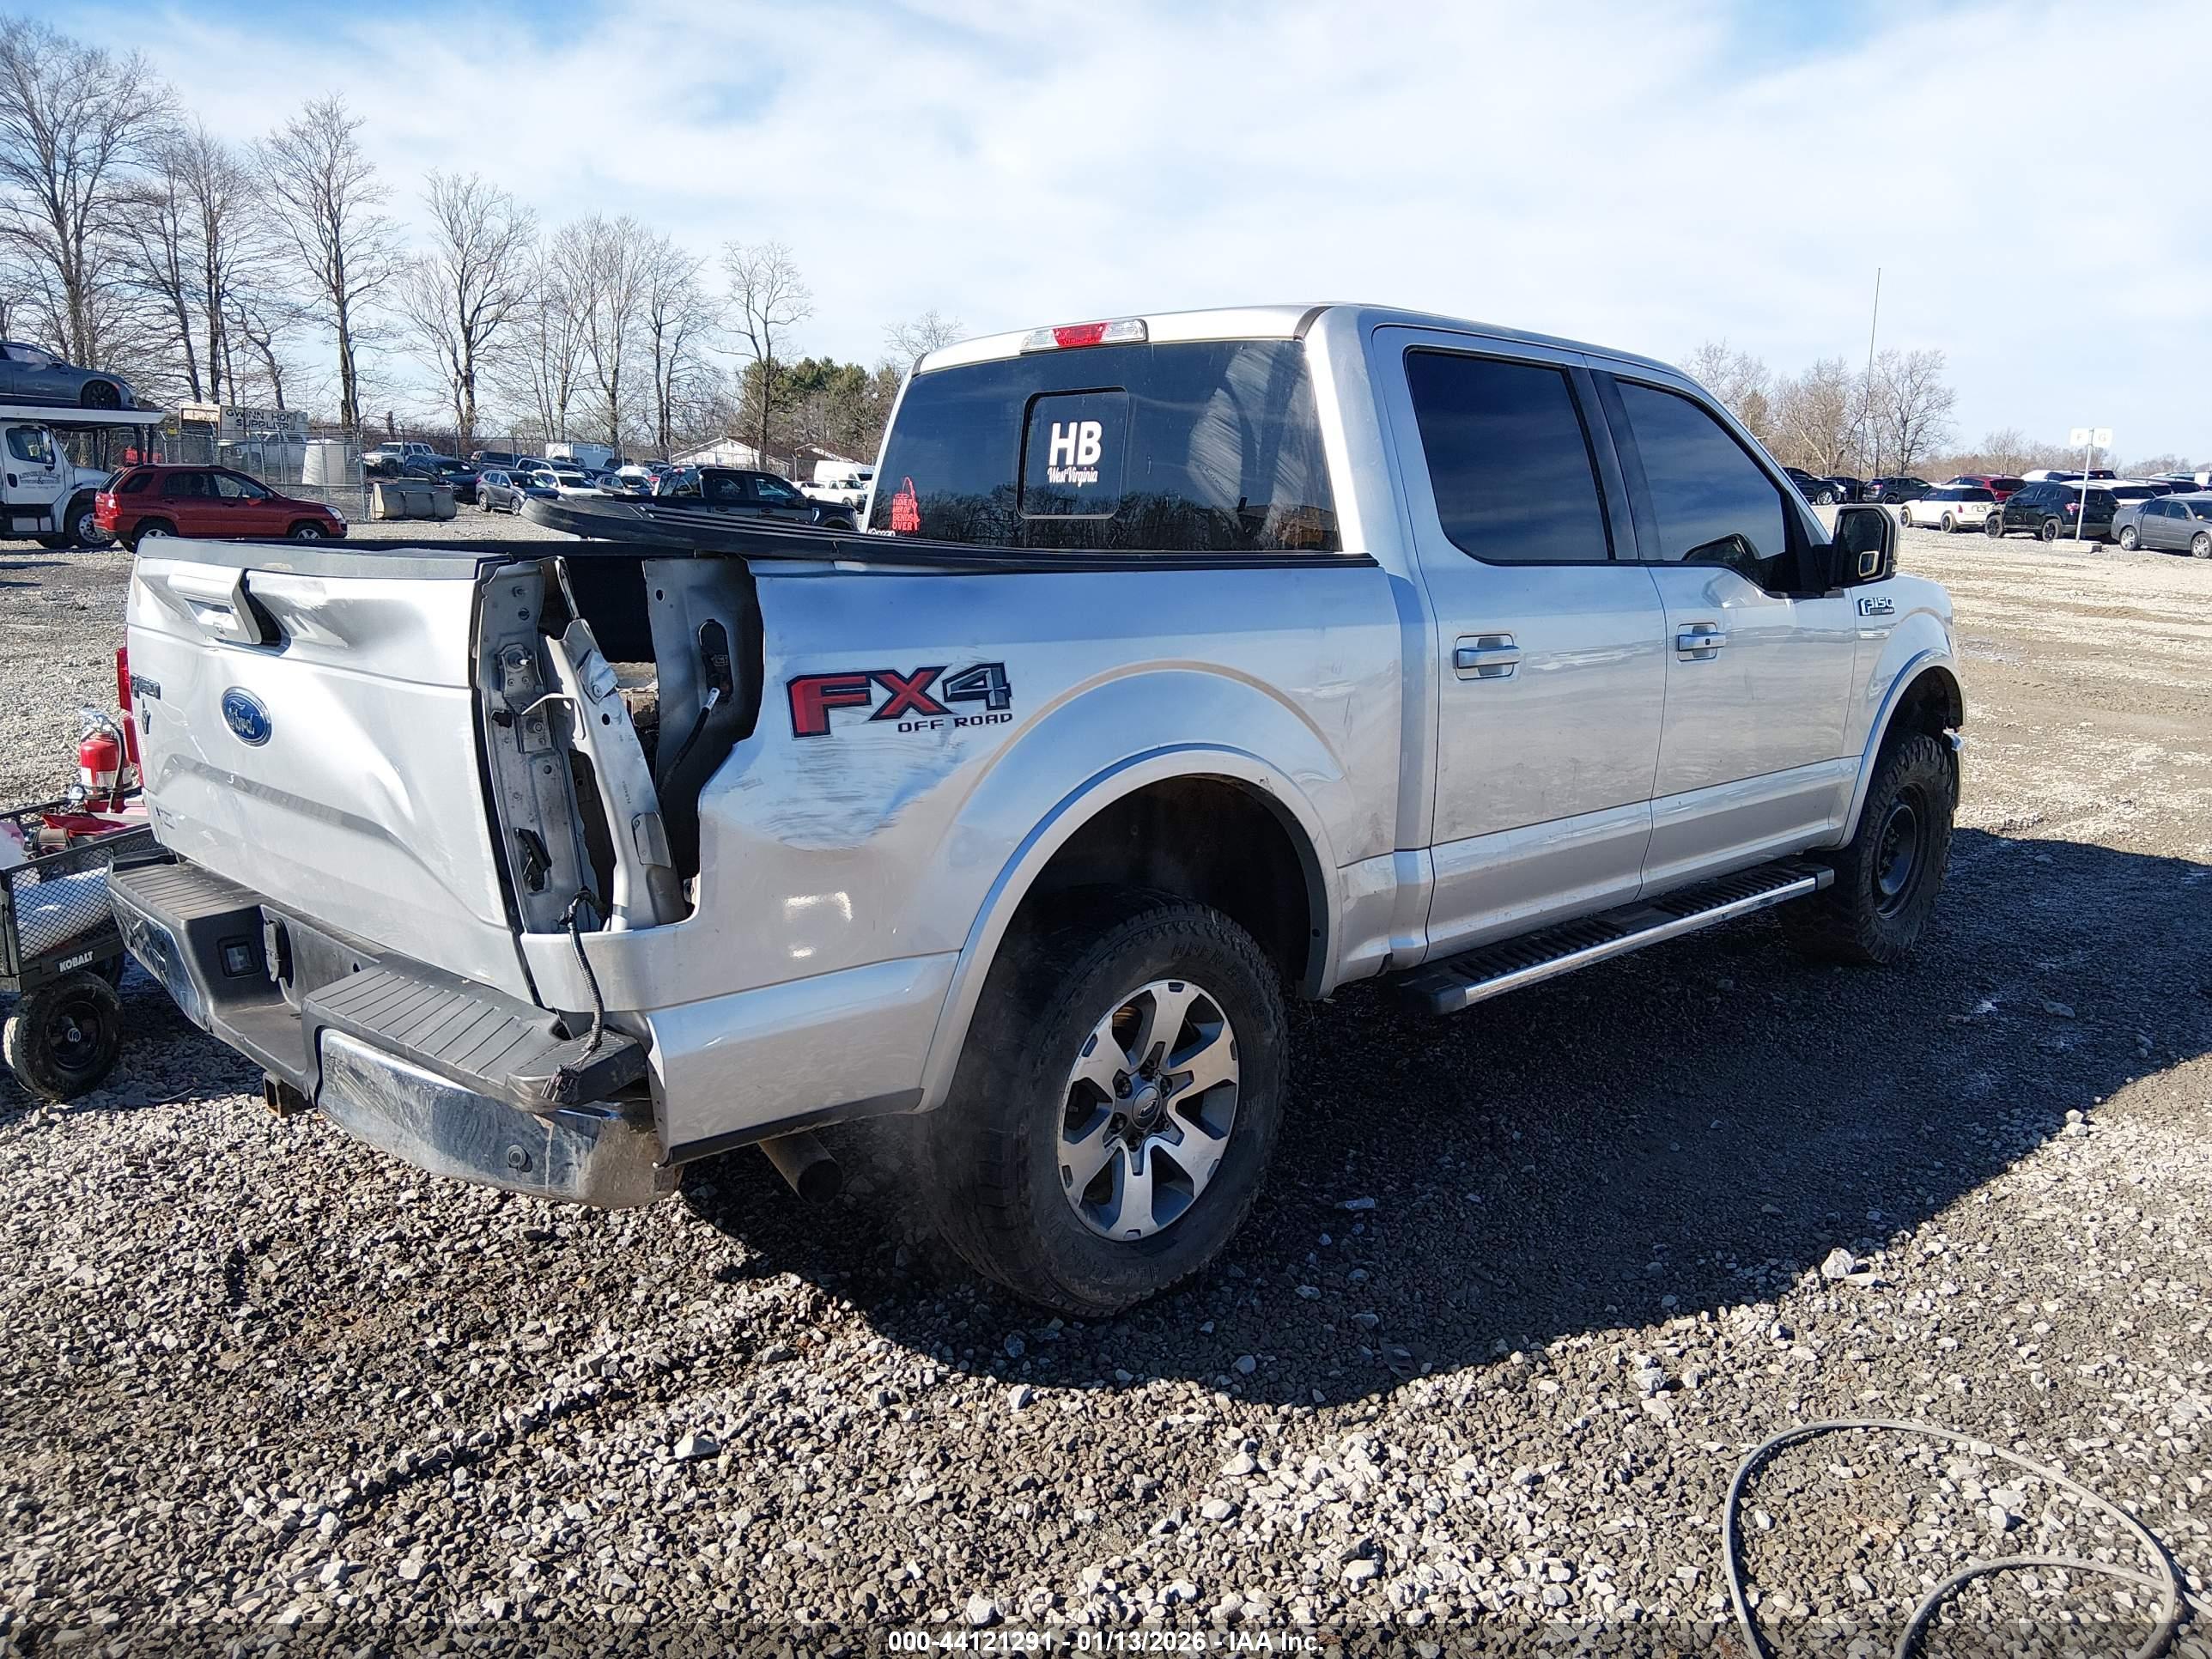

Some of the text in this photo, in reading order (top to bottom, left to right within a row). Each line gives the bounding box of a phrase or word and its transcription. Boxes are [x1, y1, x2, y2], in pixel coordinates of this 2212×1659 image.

[1049, 421, 1102, 466] HB
[1048, 466, 1098, 488] West Virginia
[892, 521, 913, 531] OVER
[785, 662, 1012, 738] FX4
[897, 713, 1013, 733] OFF ROAD
[59, 951, 94, 973] KOBALT
